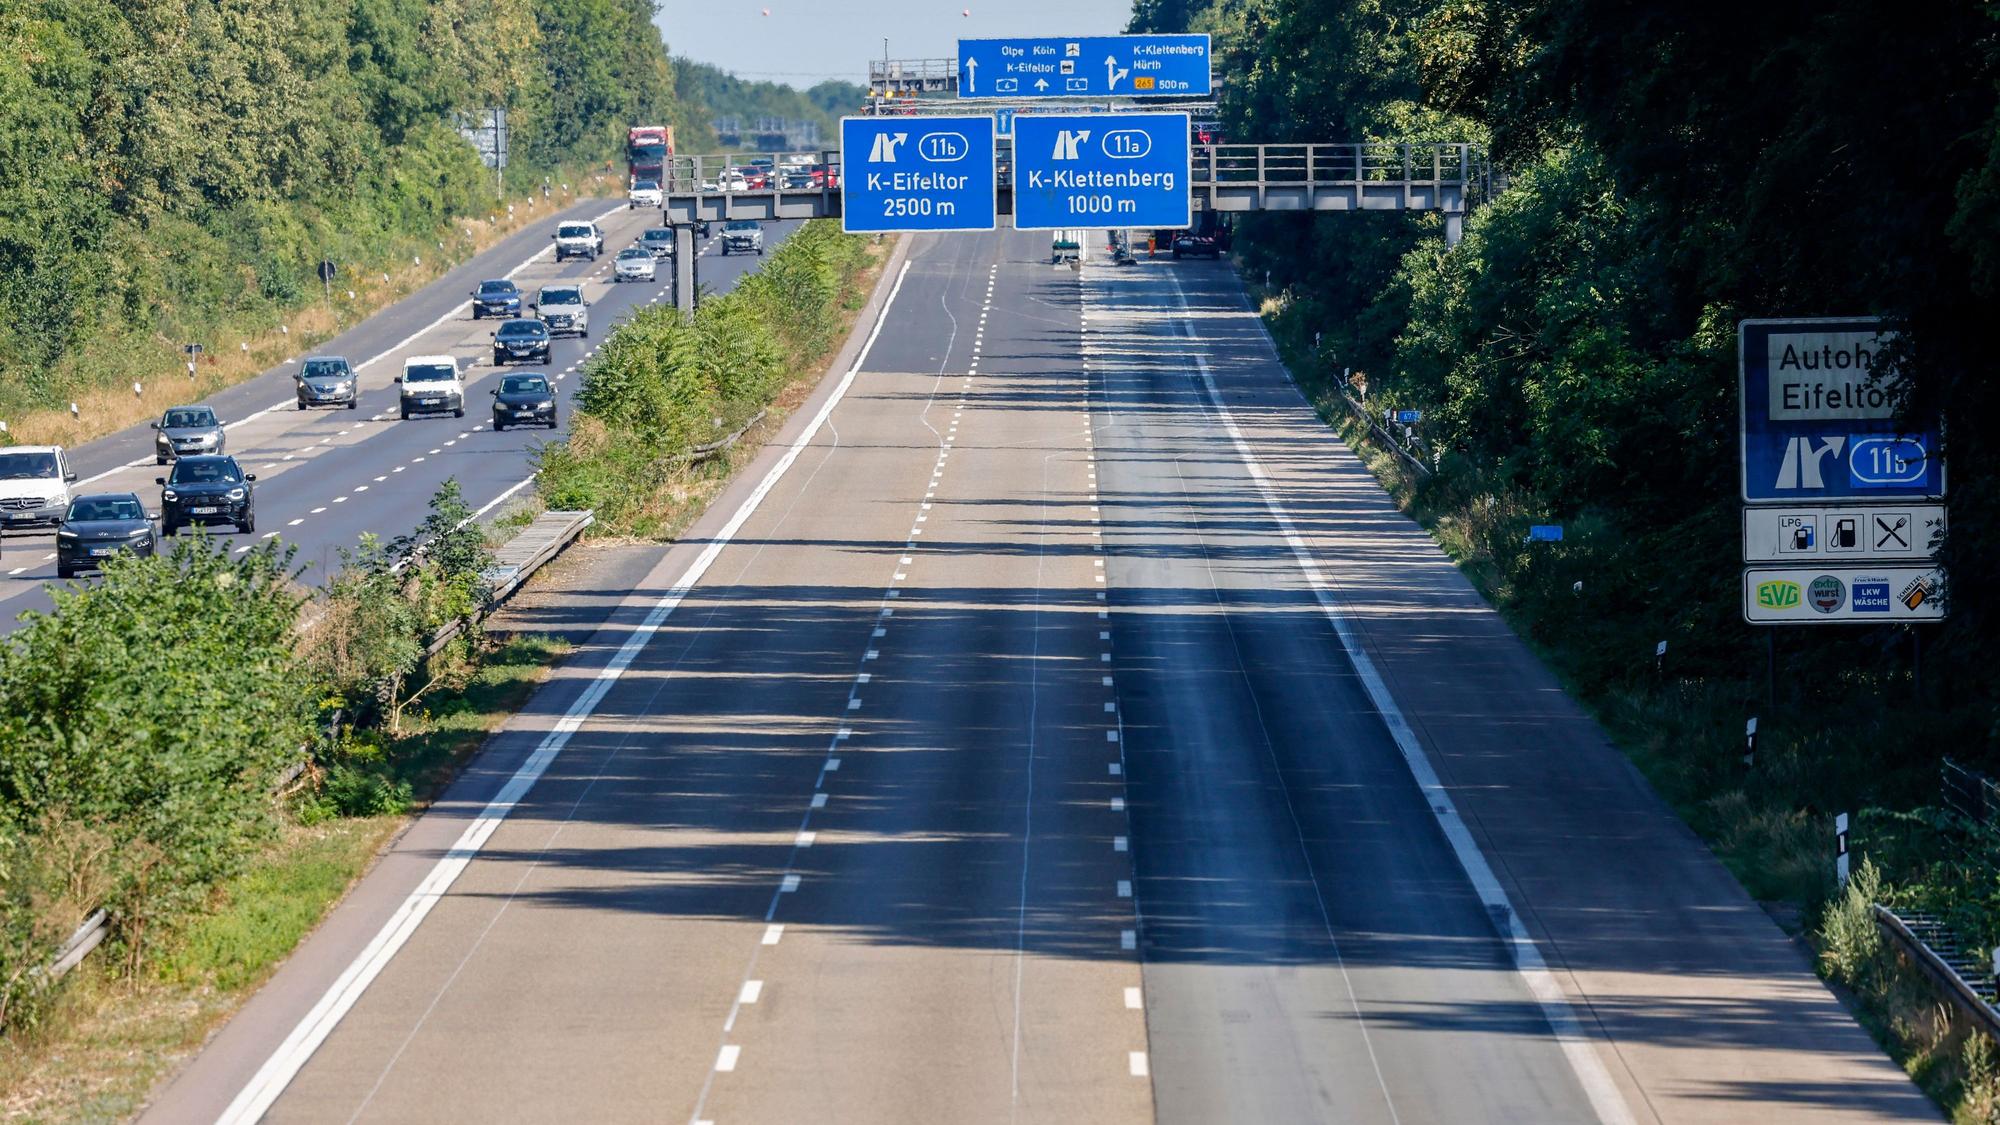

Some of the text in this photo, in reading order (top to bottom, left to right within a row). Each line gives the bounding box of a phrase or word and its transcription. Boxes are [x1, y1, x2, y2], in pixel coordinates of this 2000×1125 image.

[1001, 45, 1056, 58] Olpe Köln
[1133, 44, 1204, 57] K-Klettenberg
[1006, 62, 1056, 73] K-Eifeltor
[1133, 59, 1162, 70] Hürth
[1136, 79, 1152, 89] 265
[1158, 79, 1189, 90] 500 m
[930, 138, 957, 157] 11b
[1113, 135, 1141, 154] 11a
[867, 171, 969, 192] K-Eifeltor
[1028, 168, 1175, 191] K-Klettenberg
[883, 198, 955, 217] 2500 m
[1068, 195, 1136, 214] 1000 m
[1780, 342, 1884, 370] Autoh
[1869, 446, 1908, 475] 11b
[1781, 518, 1802, 528] LPG
[1814, 578, 1840, 588] extra
[1896, 575, 1923, 600] SCHNITZEL
[1759, 584, 1798, 606] SVG
[1814, 588, 1840, 598] wurst
[1861, 588, 1881, 596] LKW
[1853, 596, 1889, 606] WÄSCHE
